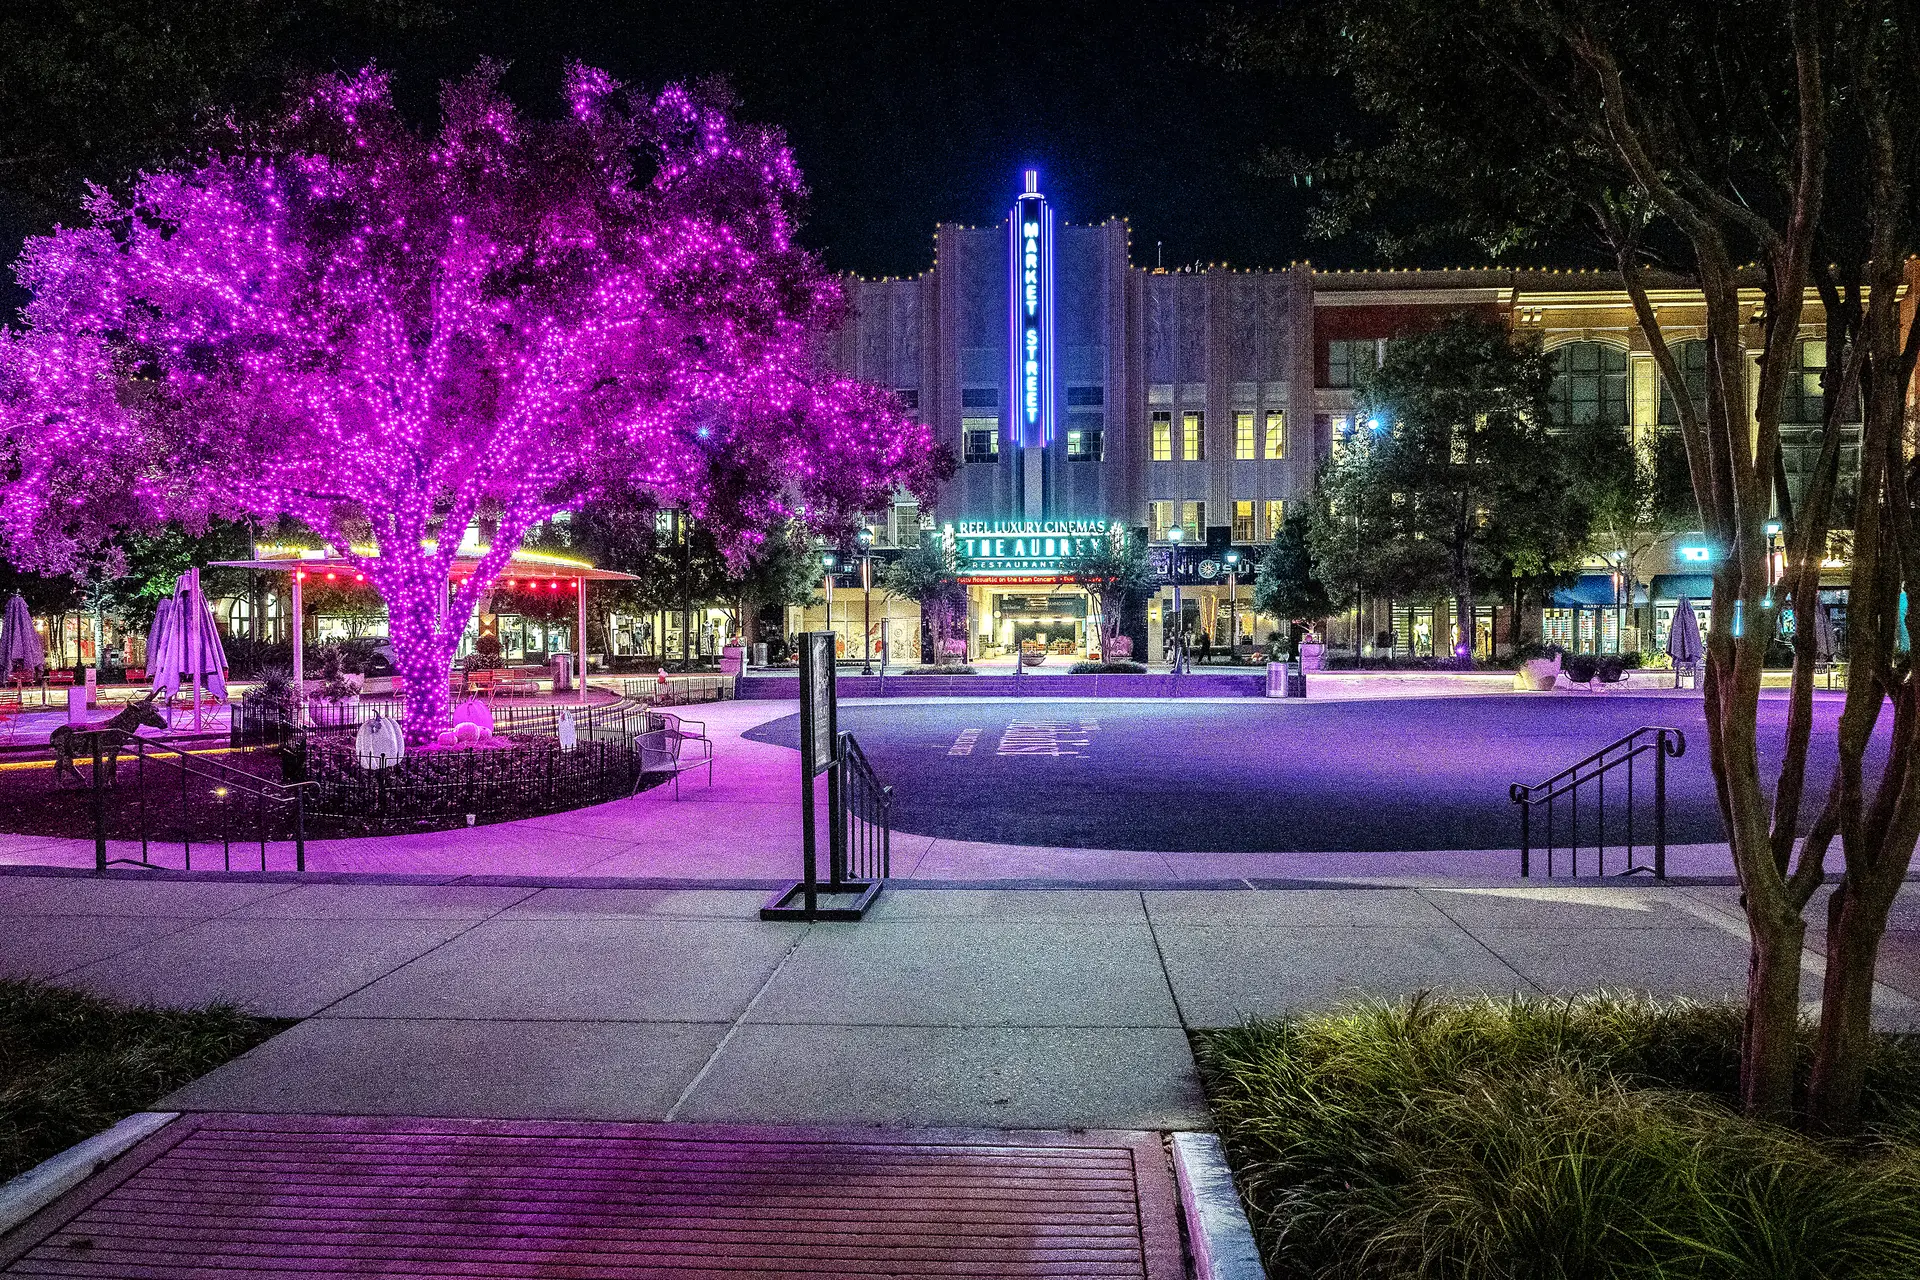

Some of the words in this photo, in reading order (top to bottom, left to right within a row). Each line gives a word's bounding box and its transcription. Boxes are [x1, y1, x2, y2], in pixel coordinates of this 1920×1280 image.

[1024, 222, 1039, 315] MARKET
[1025, 329, 1038, 424] STREET
[960, 521, 991, 534] REEL
[995, 521, 1042, 533] LUXURY
[1044, 520, 1105, 533] CINEMAS
[966, 539, 1005, 556] THE
[1014, 538, 1101, 557] AUDREY
